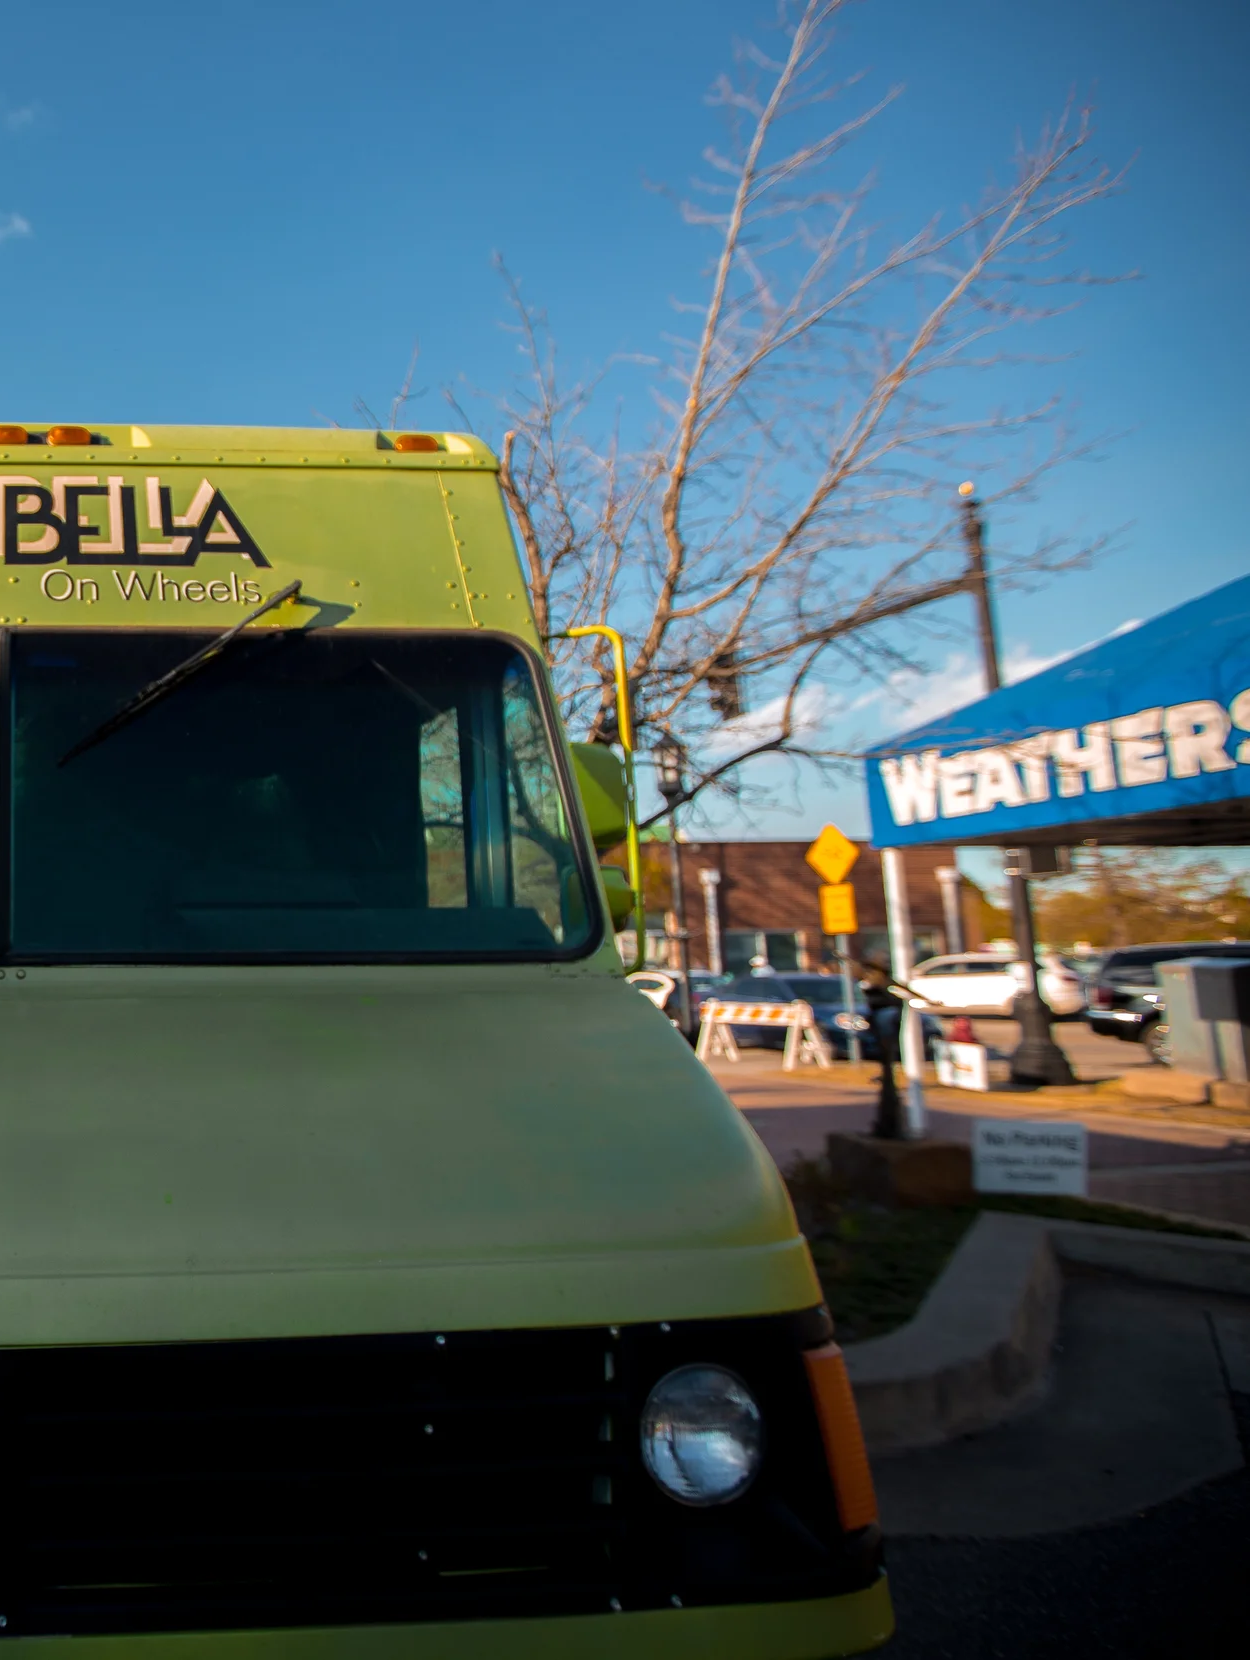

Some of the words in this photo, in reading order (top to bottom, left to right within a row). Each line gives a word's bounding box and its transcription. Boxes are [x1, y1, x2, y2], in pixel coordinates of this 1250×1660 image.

[41, 569, 98, 602] On
[112, 570, 262, 604] Wheels
[982, 1130, 1006, 1146] No
